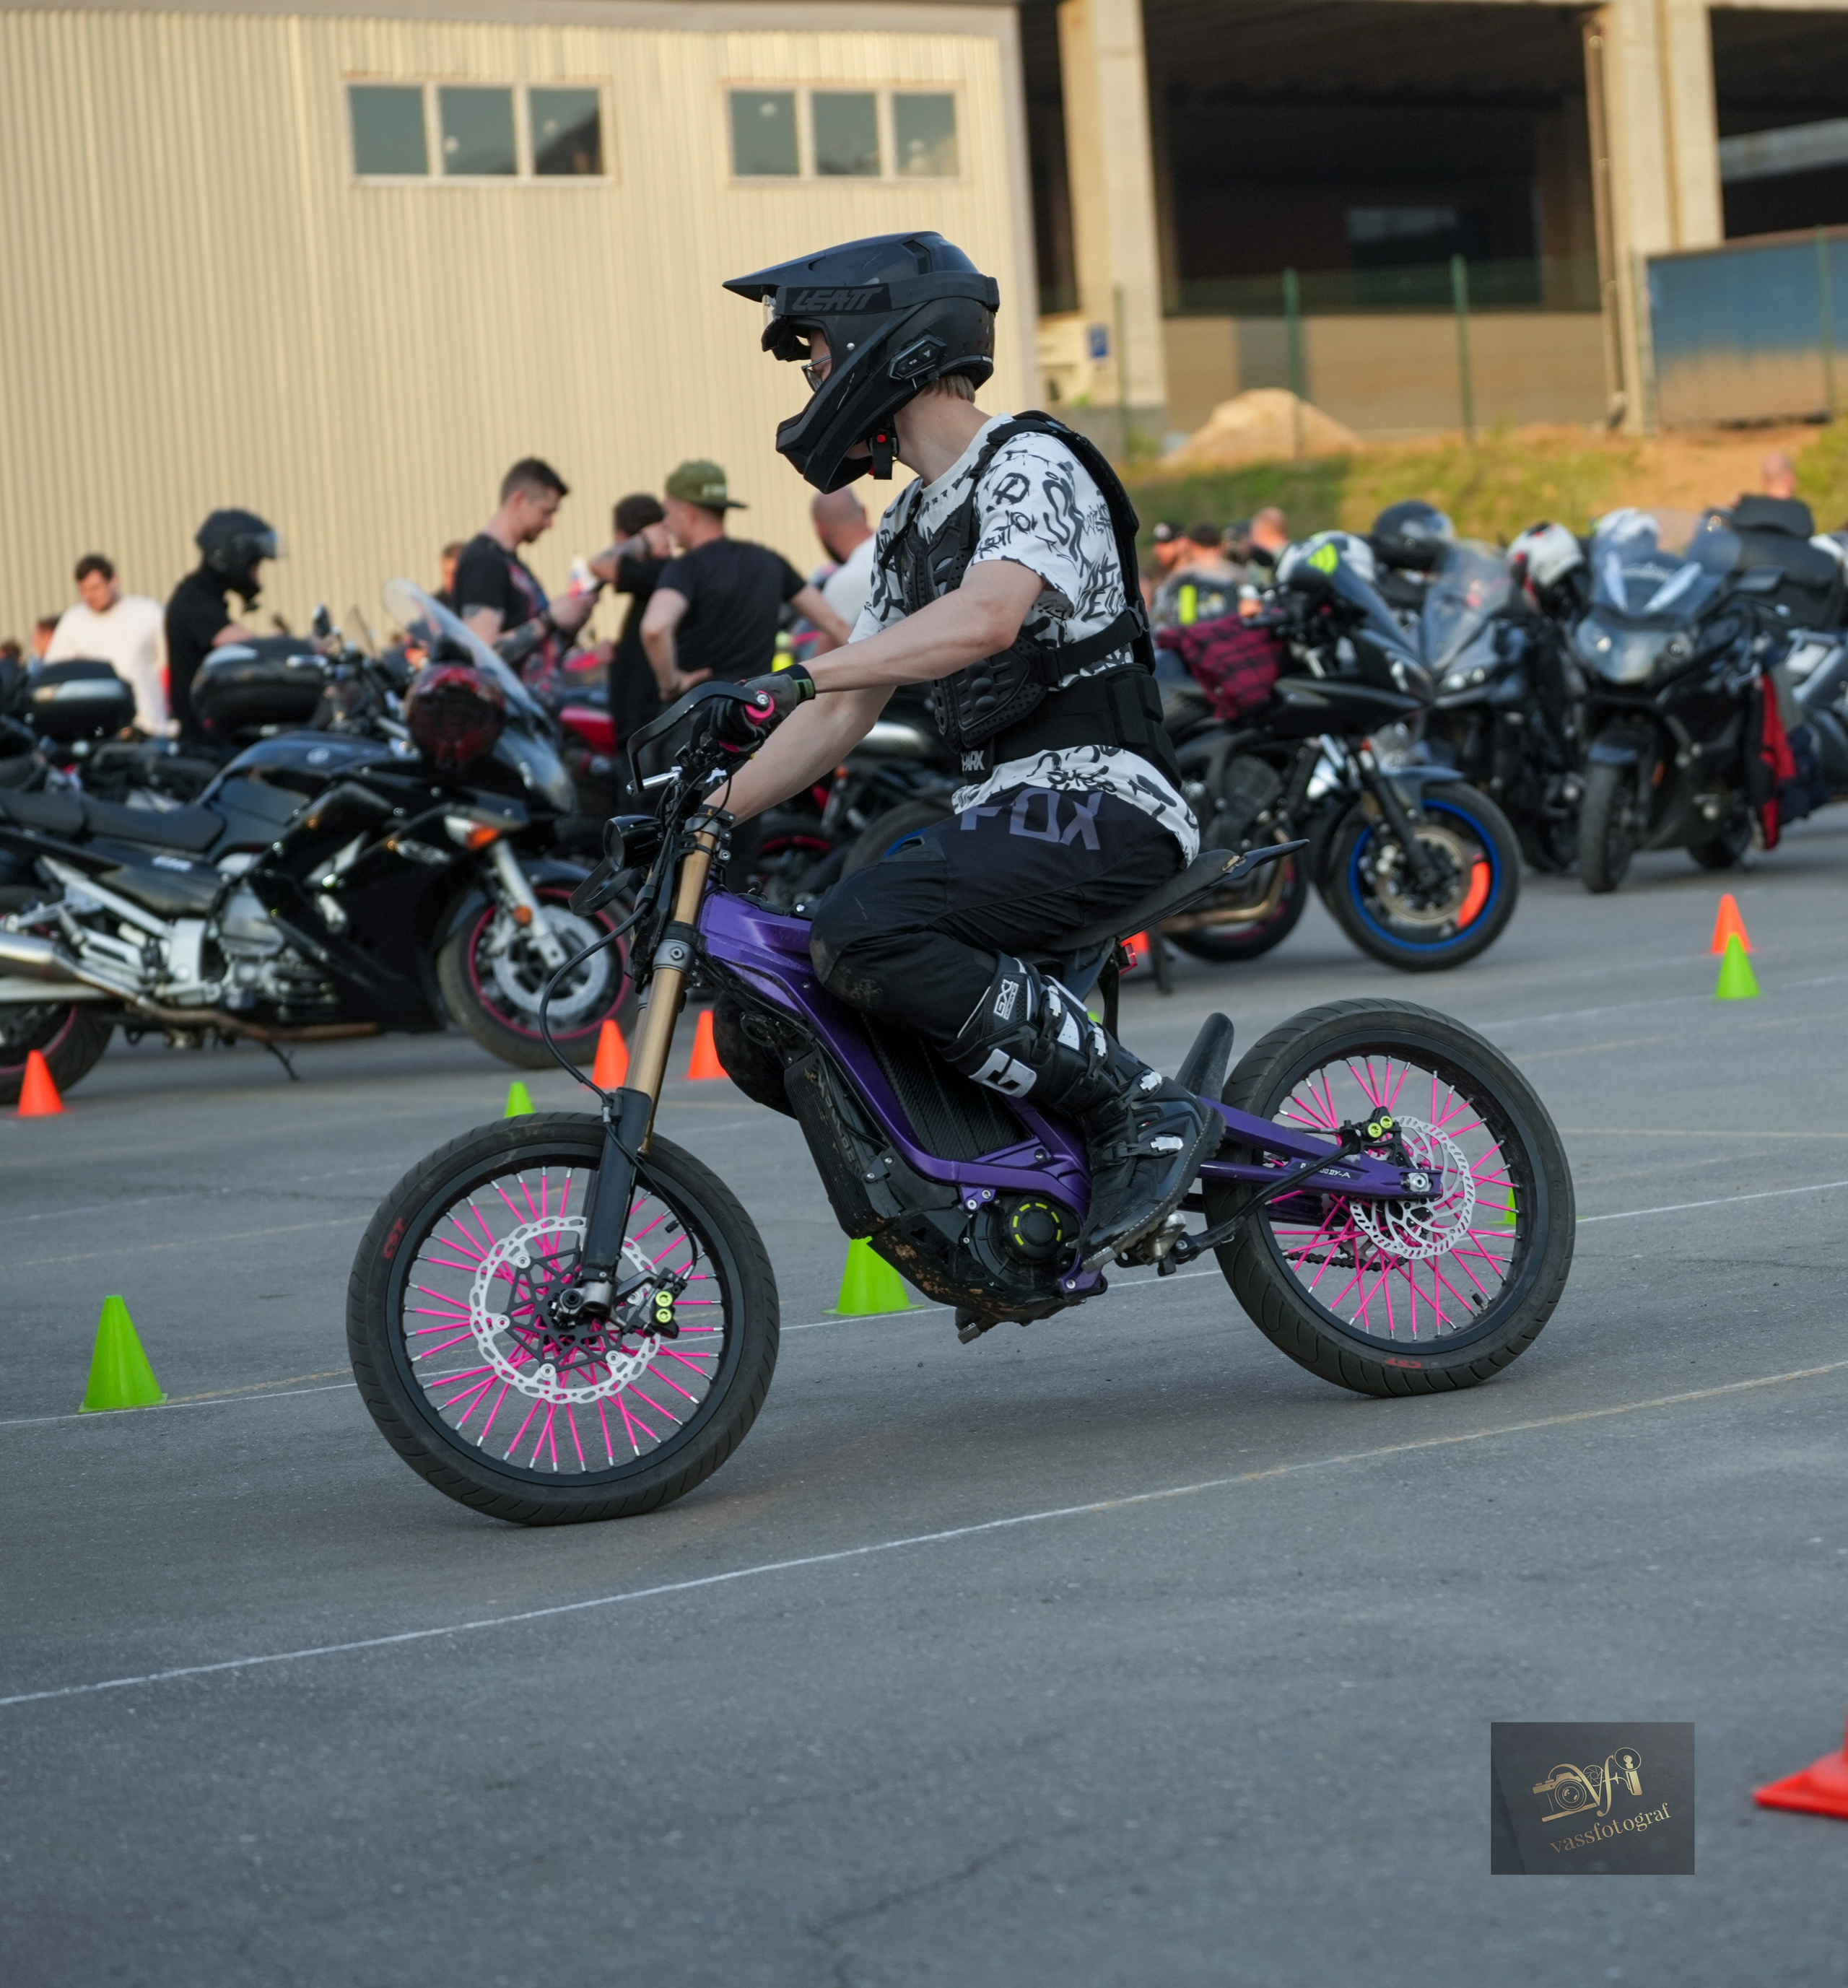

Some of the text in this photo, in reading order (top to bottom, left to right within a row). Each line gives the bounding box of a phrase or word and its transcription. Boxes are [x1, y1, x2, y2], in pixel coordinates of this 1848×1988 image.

[792, 287, 884, 311] LEATT
[960, 787, 1104, 850] FOX
[383, 1217, 404, 1259] CST
[1385, 1357, 1422, 1369] CST
